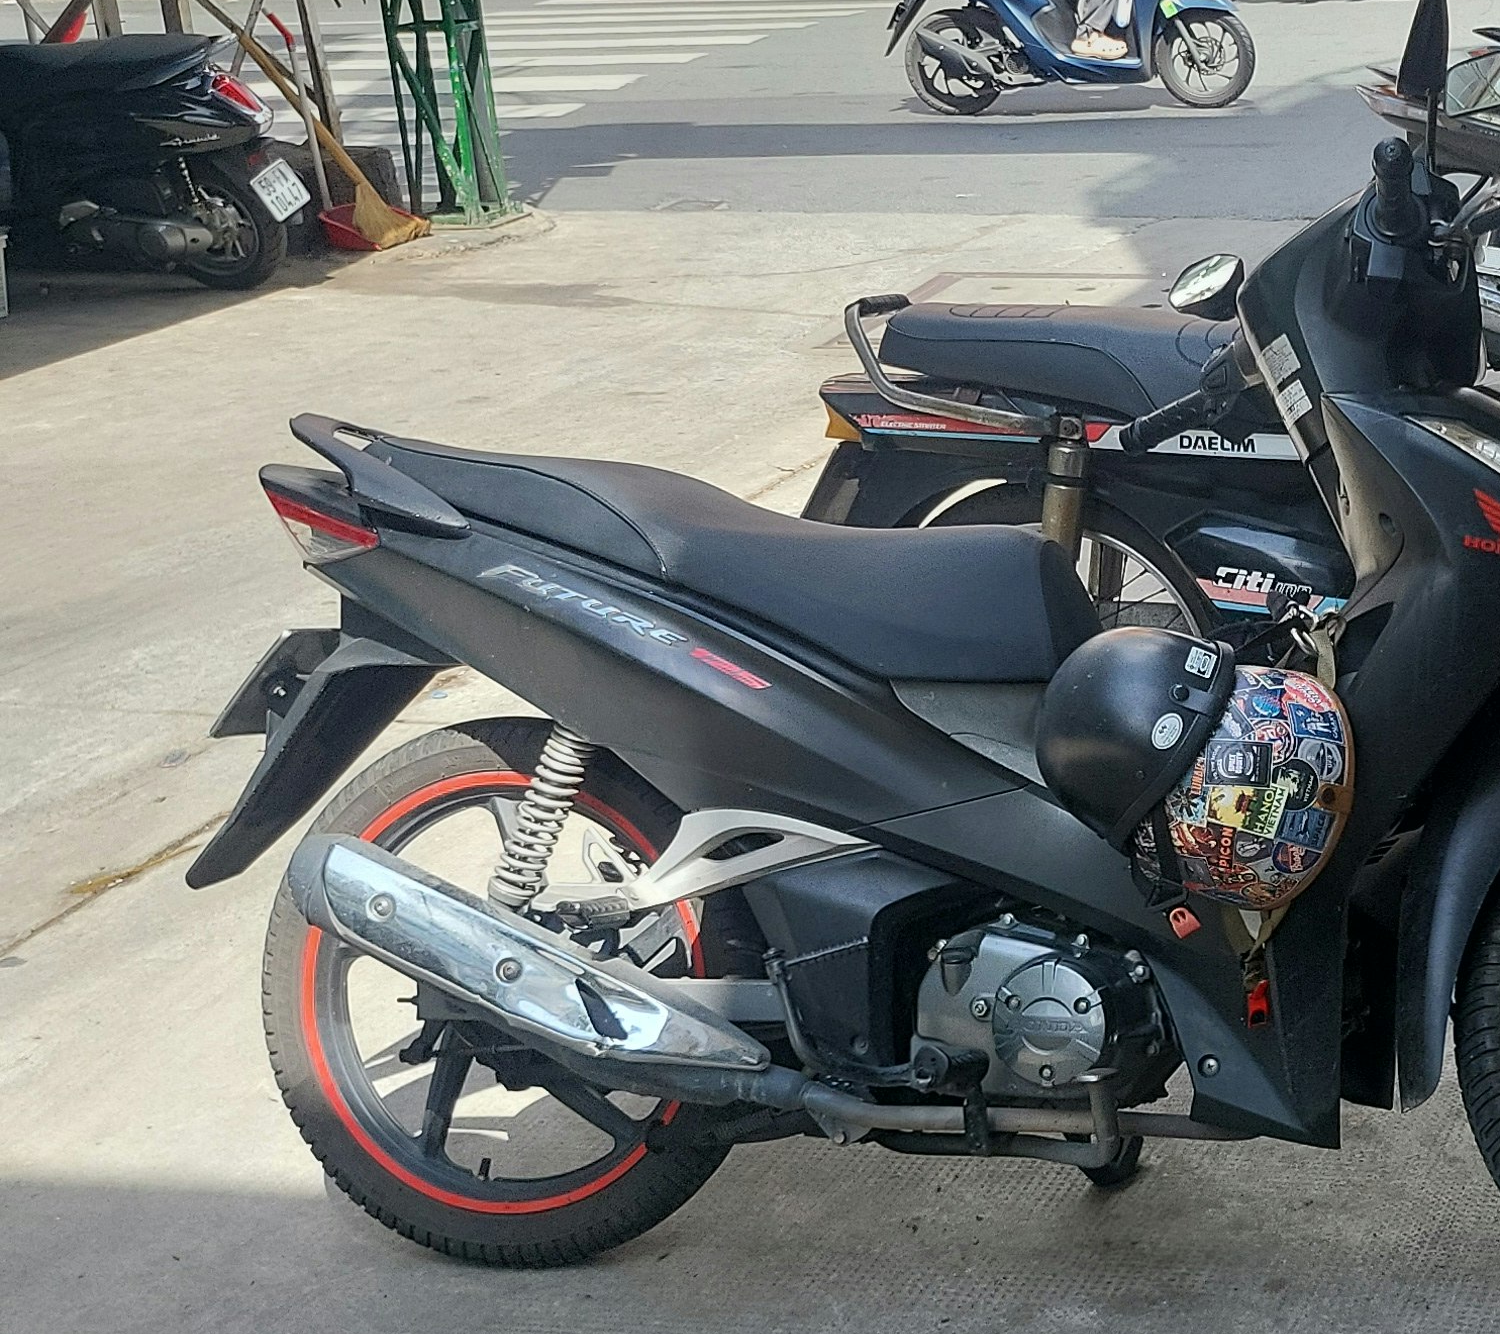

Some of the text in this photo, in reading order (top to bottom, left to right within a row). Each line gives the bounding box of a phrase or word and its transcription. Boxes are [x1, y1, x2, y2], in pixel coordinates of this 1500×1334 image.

[1179, 435, 1256, 454] DAELIM
[1212, 567, 1275, 595] Citi
[476, 563, 688, 648] FUTURE
[1263, 786, 1286, 838] VIETNAM
